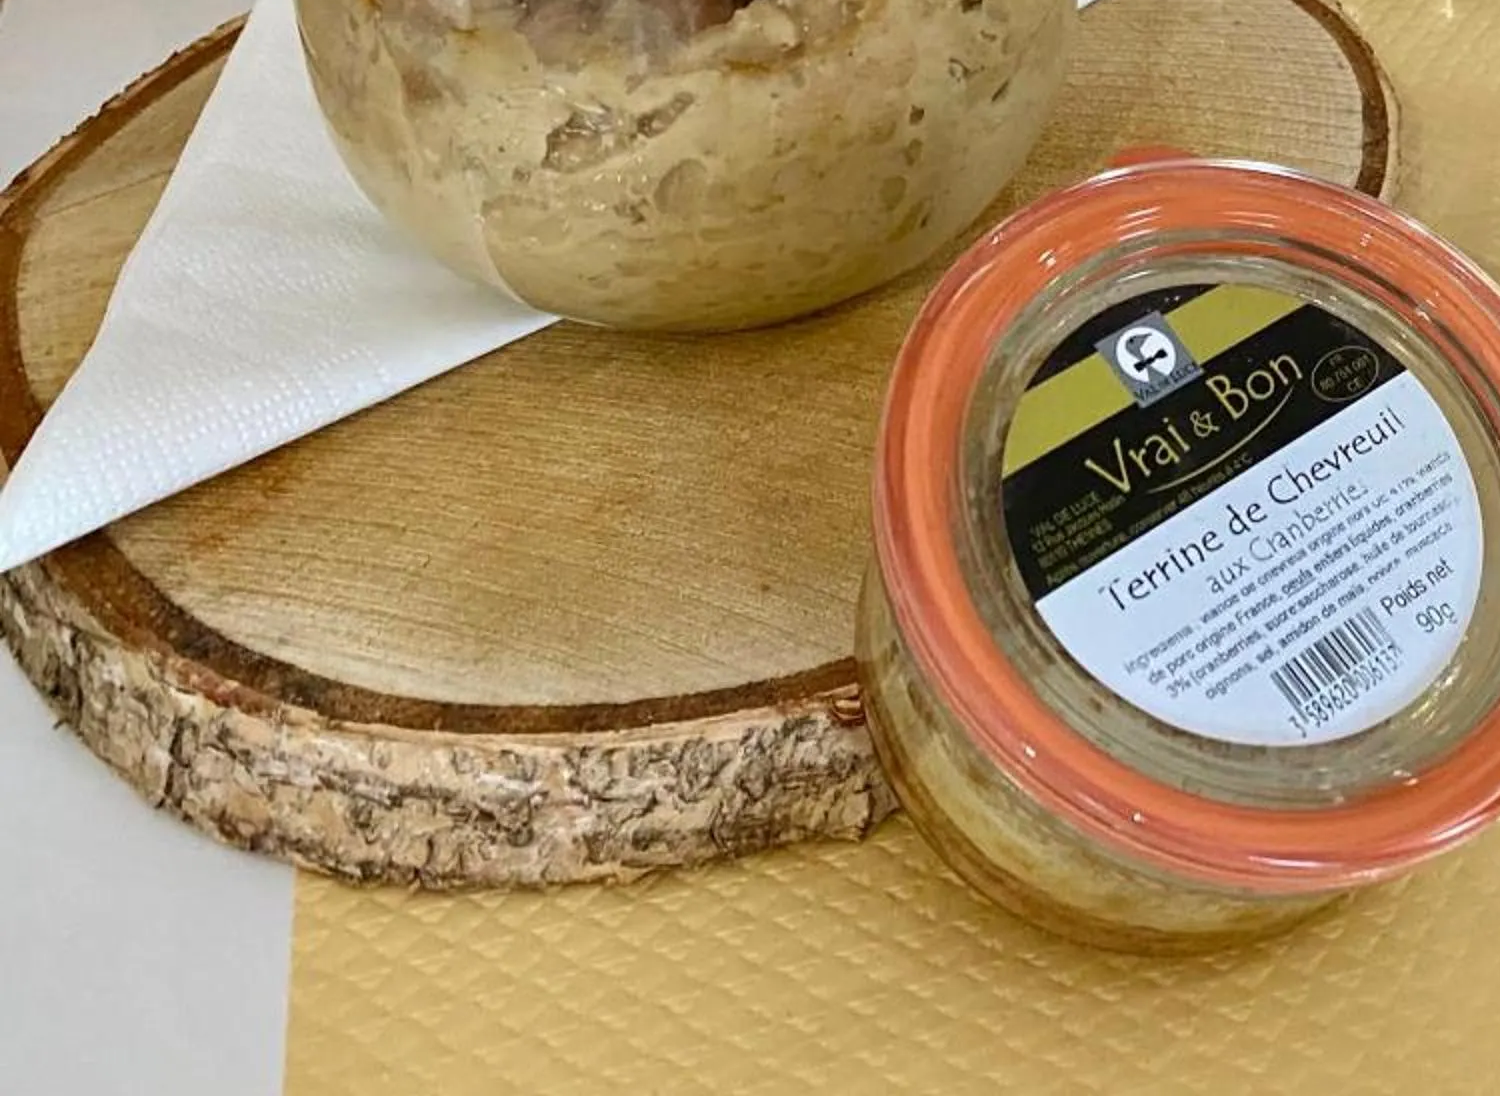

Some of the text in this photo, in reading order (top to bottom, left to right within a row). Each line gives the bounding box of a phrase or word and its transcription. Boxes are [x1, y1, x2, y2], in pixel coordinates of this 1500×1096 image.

[1085, 354, 1304, 493] Vrai & Bon
[1098, 530, 1224, 610] Terrine
[1226, 503, 1268, 536] de
[1267, 406, 1406, 505] Chevreuil
[1308, 522, 1347, 552] origine
[1207, 556, 1250, 594] aux
[1380, 557, 1455, 616] Poids net
[1165, 678, 1192, 699] 3%
[1390, 530, 1405, 545] de
[1279, 613, 1321, 649] amidon
[1321, 602, 1338, 619] de
[1416, 602, 1458, 634] 90g
[1149, 668, 1167, 686] de
[1166, 649, 1195, 676] porc
[1195, 620, 1237, 654] origine
